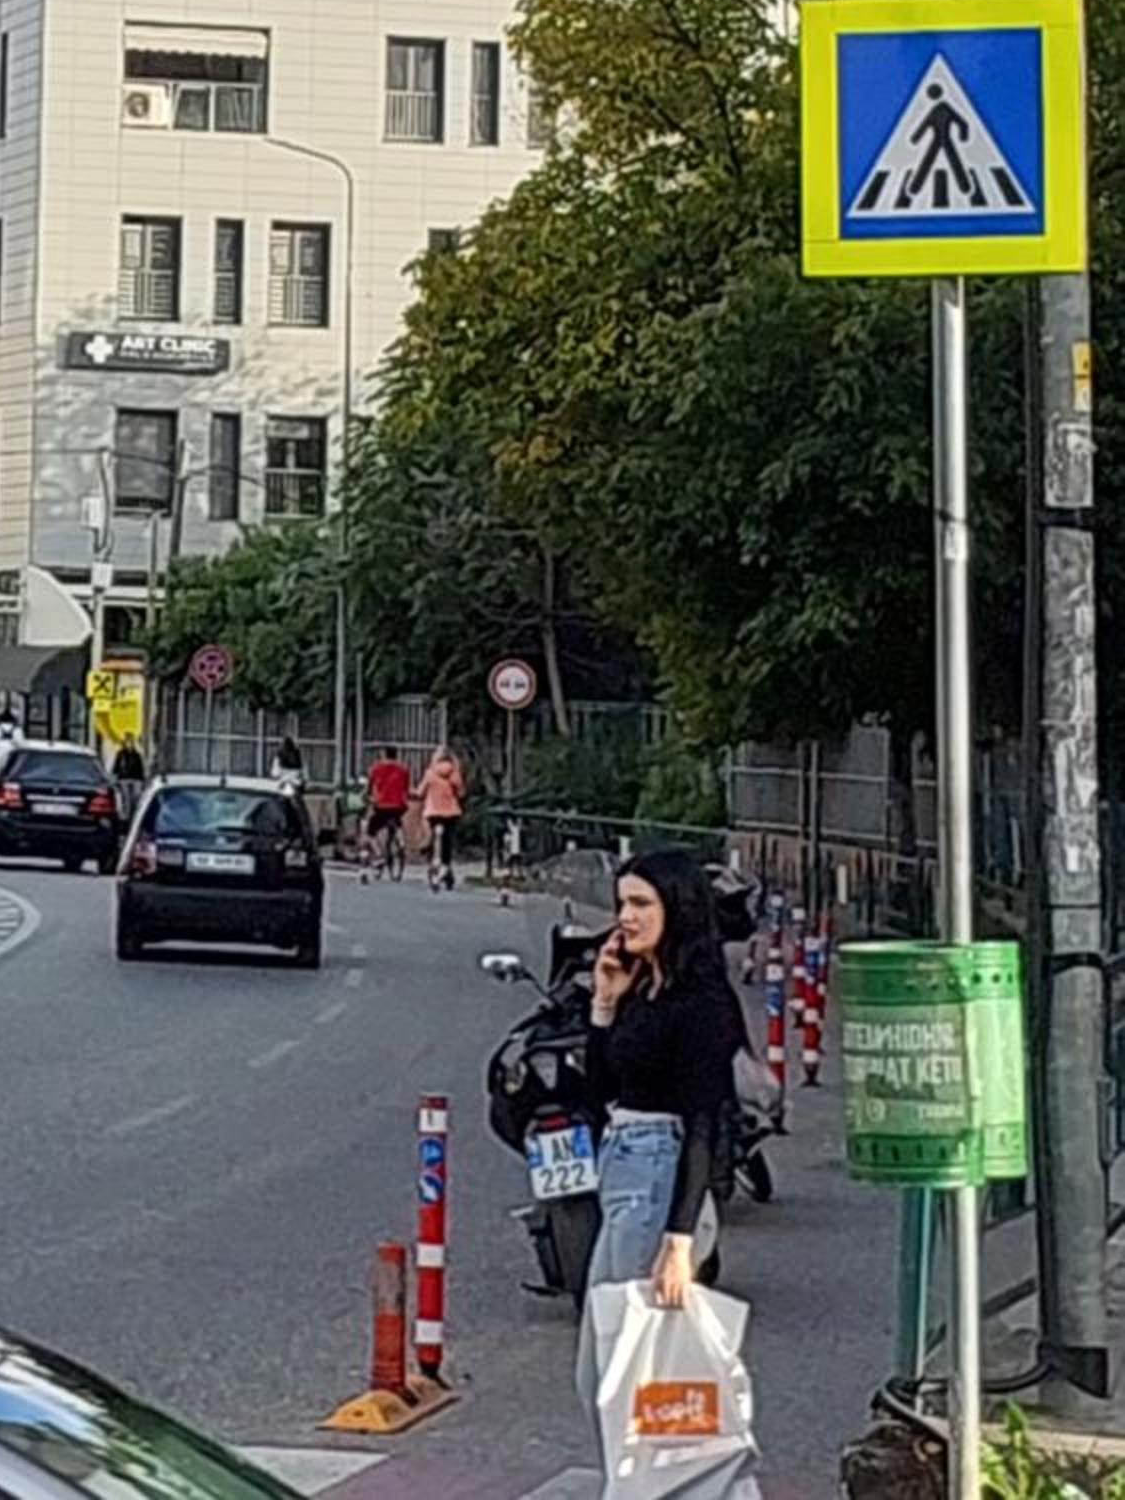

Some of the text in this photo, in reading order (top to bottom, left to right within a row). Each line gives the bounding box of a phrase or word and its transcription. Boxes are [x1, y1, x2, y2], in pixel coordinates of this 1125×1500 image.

[121, 335, 217, 354] ART CLINIC
[539, 1162, 587, 1194] 222
